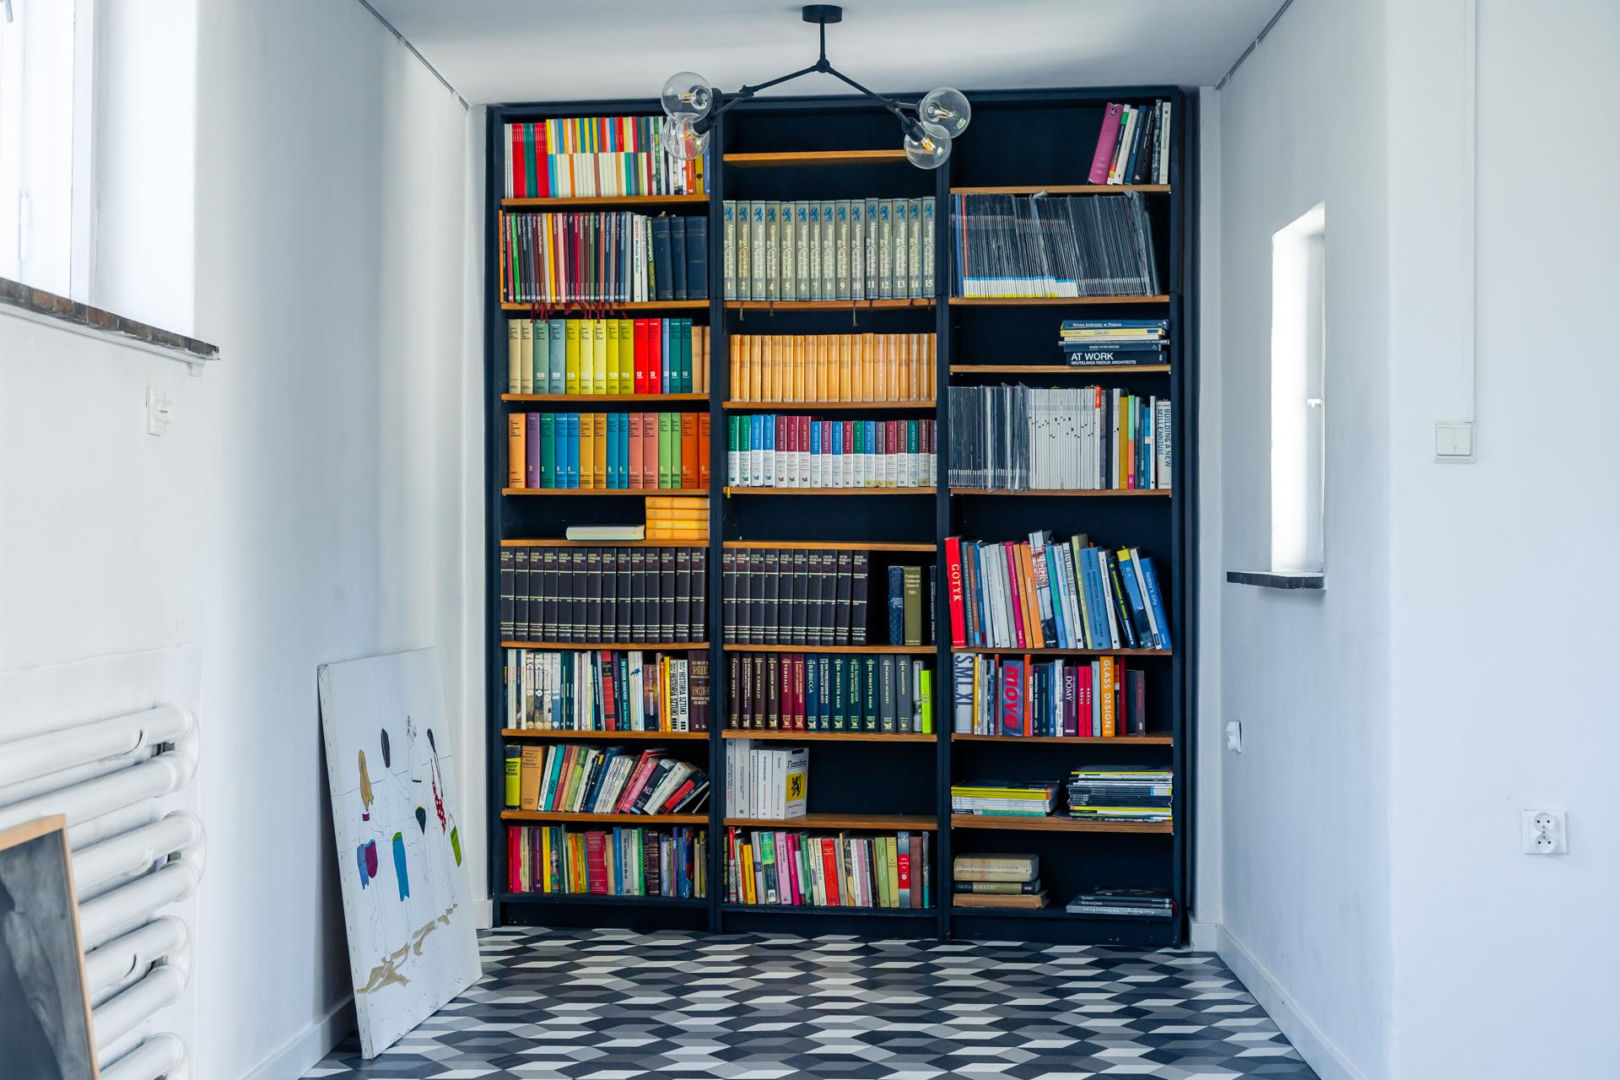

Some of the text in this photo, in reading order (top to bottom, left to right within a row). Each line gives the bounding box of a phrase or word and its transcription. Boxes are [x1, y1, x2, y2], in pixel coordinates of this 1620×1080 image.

[1071, 352, 1114, 361] AT WORK
[952, 563, 961, 602] GOTYK
[535, 689, 543, 697] 9
[1004, 666, 1019, 728] move
[1065, 675, 1073, 701] DOMY
[1103, 659, 1112, 728] GLASS DESIGN
[679, 696, 687, 715] SZTUKI
